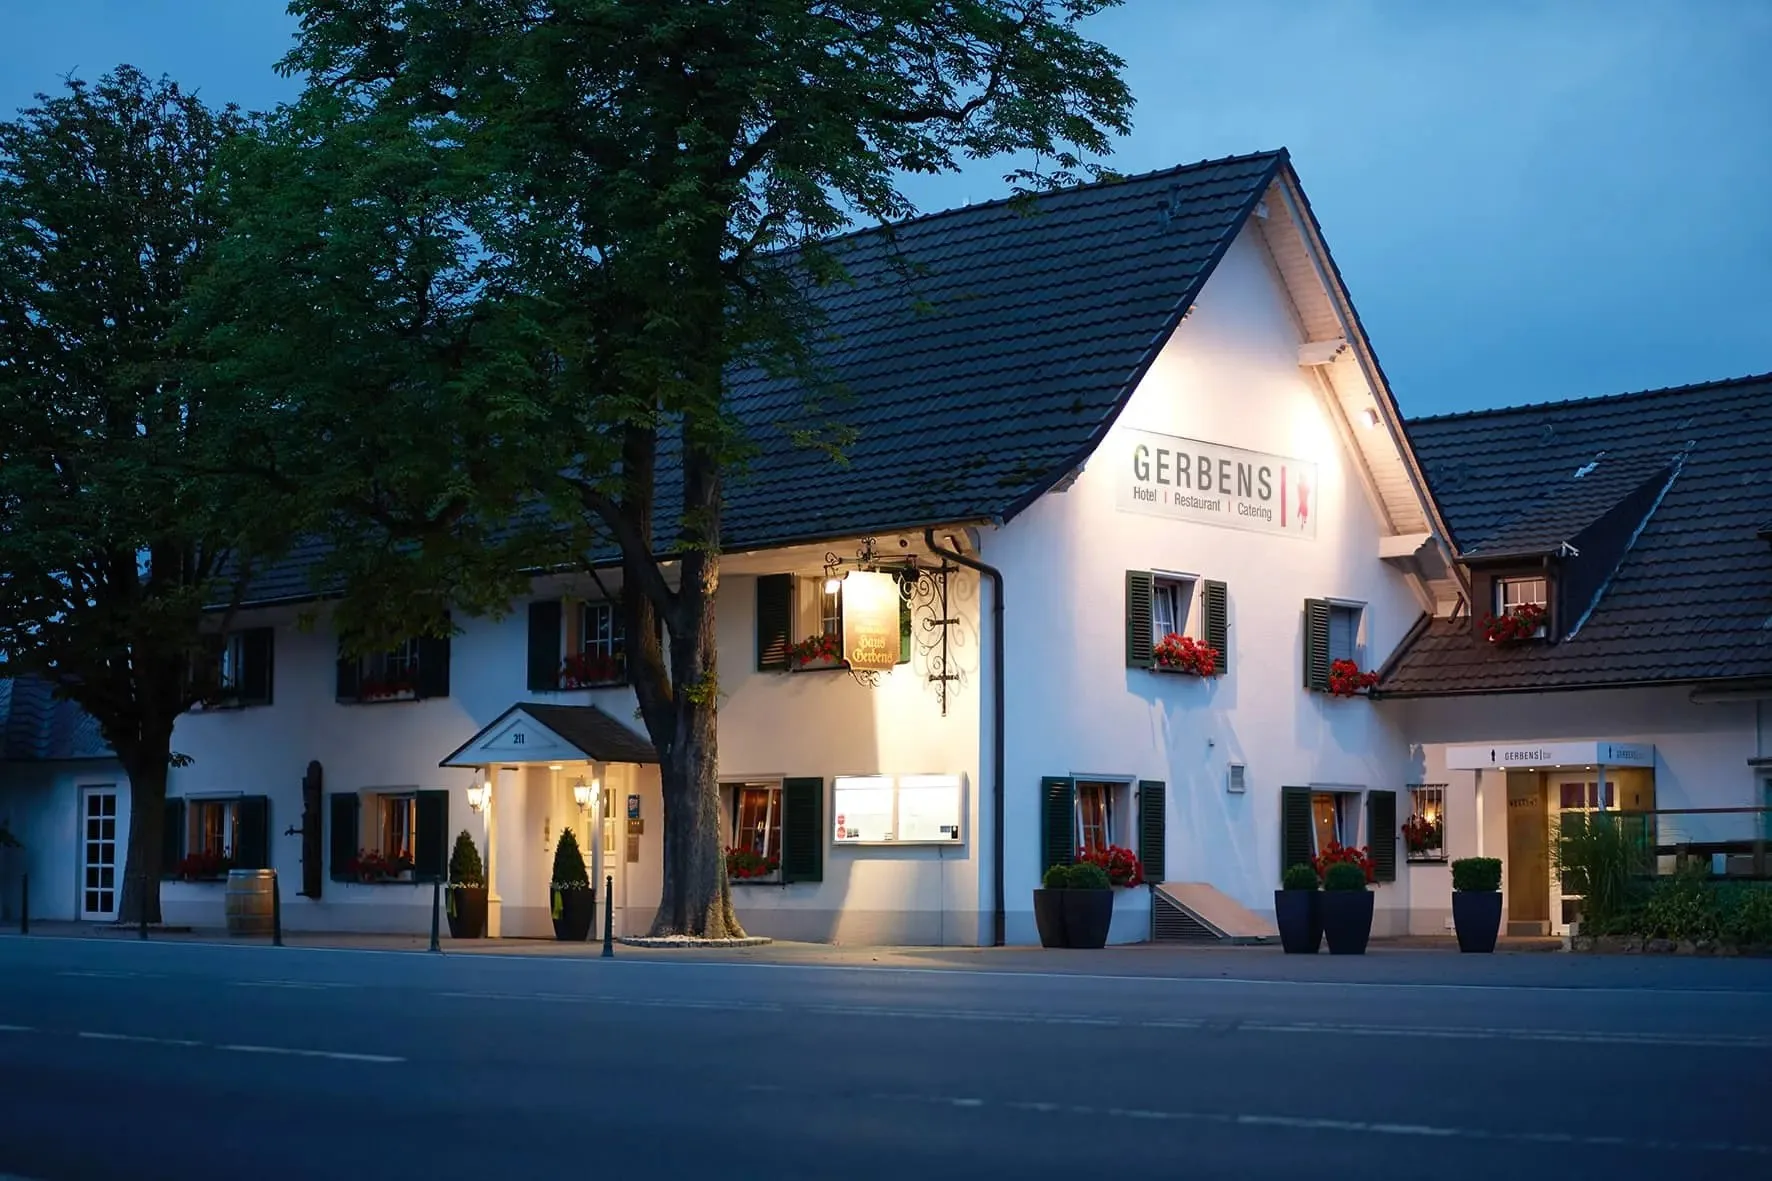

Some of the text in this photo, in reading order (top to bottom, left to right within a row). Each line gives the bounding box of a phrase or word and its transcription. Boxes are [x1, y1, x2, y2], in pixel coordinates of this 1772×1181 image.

[1133, 444, 1272, 500] GERBENS
[1133, 486, 1272, 521] Hotel Restaurant Catering
[852, 648, 893, 663] Gerbens
[513, 733, 525, 744] 211
[1504, 751, 1539, 761] GERBENS
